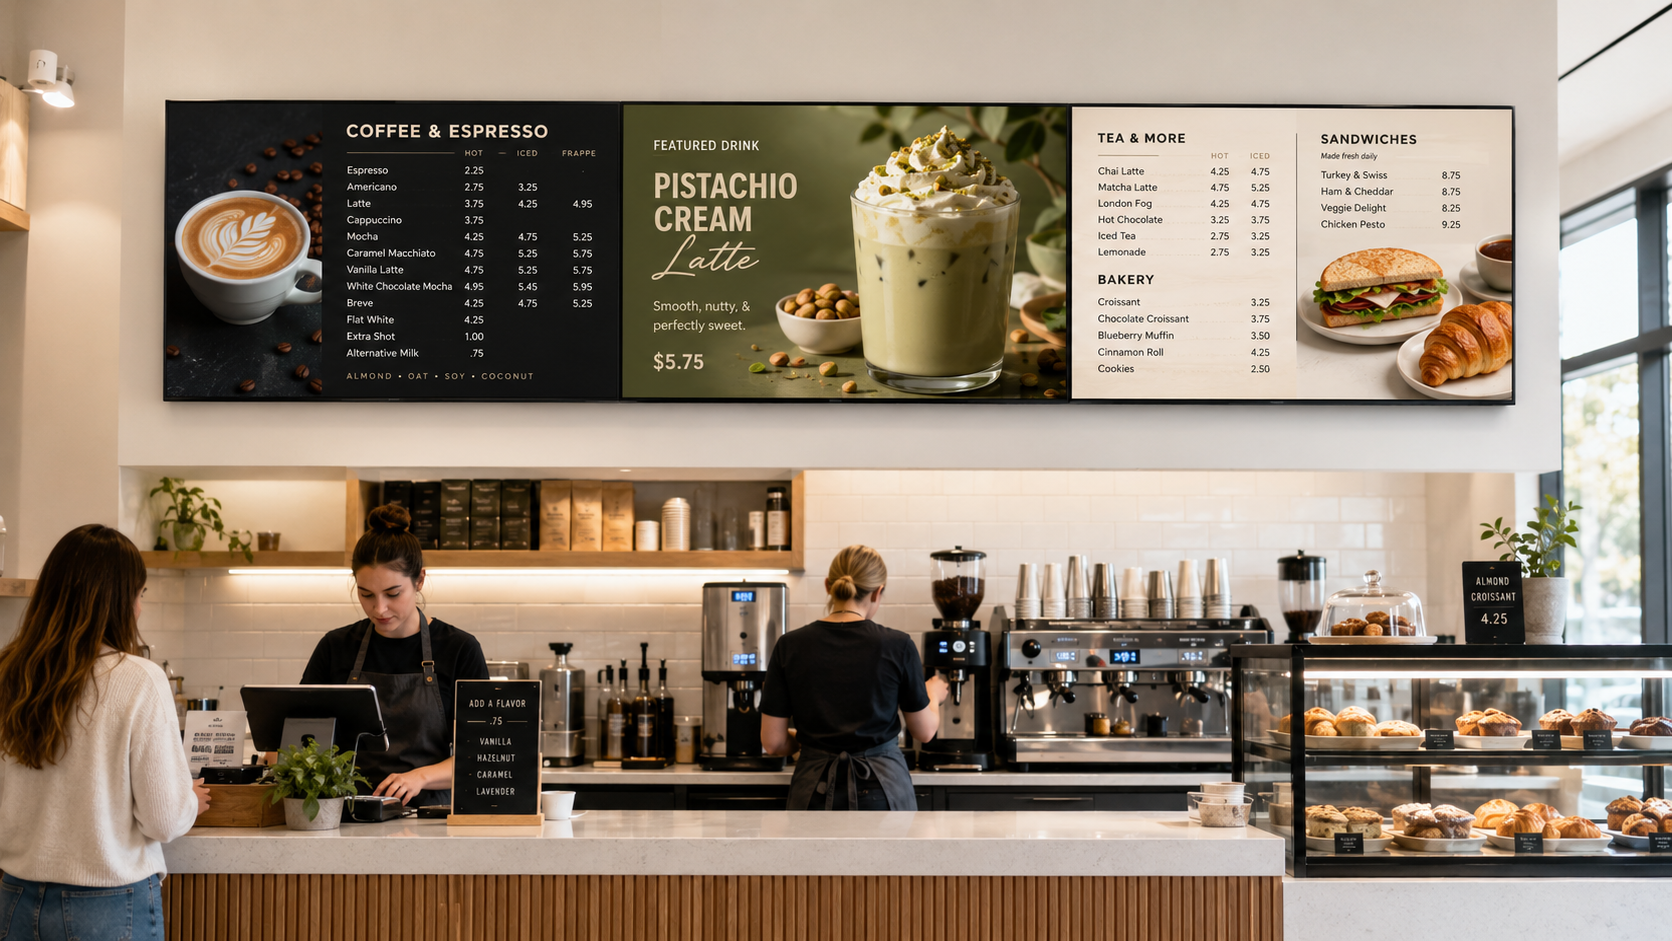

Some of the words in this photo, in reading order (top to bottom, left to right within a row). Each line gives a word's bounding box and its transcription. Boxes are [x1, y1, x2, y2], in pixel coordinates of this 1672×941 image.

[346, 123, 421, 138] COFFEE
[428, 124, 442, 139] &
[449, 124, 549, 139] ESPRESSO
[1097, 132, 1125, 144] TEA
[1129, 132, 1139, 144] &
[1144, 132, 1186, 144] MORE
[1320, 133, 1417, 145] SANDWICHES
[653, 139, 717, 151] FEATURED
[721, 139, 760, 151] DRINK
[464, 149, 484, 157] HOT
[516, 149, 538, 157] ICED
[561, 149, 596, 157] FRAPPE
[1210, 152, 1229, 160] HOT
[1249, 152, 1271, 160] ICED
[1320, 152, 1341, 160] Made
[1341, 151, 1360, 160] fresh
[1360, 152, 1379, 162] daily
[347, 165, 389, 176] Espresso
[464, 165, 485, 175] 2.25
[1097, 166, 1119, 176] Chai
[1121, 166, 1145, 176] Latte
[1210, 167, 1230, 176] 4.25
[1250, 167, 1270, 176] 4.75
[1320, 170, 1352, 182] Turkey
[1353, 170, 1361, 180] &
[1362, 170, 1388, 180] Swiss
[1441, 170, 1461, 180] 8.75
[346, 181, 398, 192] Americano
[464, 182, 484, 192] 2.75
[518, 182, 538, 192] 3.25
[654, 172, 798, 200] PISTACHIO
[1098, 182, 1132, 192] Matcha
[1134, 183, 1158, 192] Latte
[1210, 183, 1230, 193] 4.75
[1251, 183, 1270, 193] 5.25
[1320, 186, 1343, 196] Ham
[1344, 186, 1352, 196] &
[1353, 186, 1394, 196] Cheddar
[1441, 187, 1461, 197] 8.75
[346, 199, 372, 208] Latte
[464, 199, 484, 209] 3.75
[517, 199, 538, 209] 4.25
[572, 199, 593, 209] 4.95
[1097, 198, 1133, 208] London
[1134, 198, 1153, 210] Fog
[1210, 199, 1230, 208] 4.25
[1250, 199, 1270, 209] 4.75
[1320, 203, 1353, 215] Veggie
[1354, 203, 1387, 215] Delight
[1441, 203, 1461, 213] 8.25
[346, 215, 403, 227] Cappuccino
[464, 215, 484, 225] 3.75
[654, 205, 752, 232] CREAM
[1097, 215, 1115, 224] Hot
[1116, 215, 1164, 224] Chocolate
[1210, 215, 1230, 225] 3.25
[1251, 215, 1270, 225] 3.75
[1320, 219, 1358, 229] Chicken
[1359, 219, 1386, 229] Pesto
[1441, 220, 1461, 229] 9.25
[346, 231, 379, 241] Mocha
[464, 232, 484, 242] 4.25
[517, 232, 538, 242] 4.75
[572, 232, 593, 242] 5.25
[1097, 231, 1118, 241] Iced
[1119, 231, 1136, 241] Tea
[1210, 231, 1230, 241] 2.75
[1251, 231, 1270, 241] 3.25
[346, 248, 386, 258] Caramel
[388, 248, 436, 258] Macchiato
[464, 248, 485, 258] 4.75
[518, 248, 538, 259] 5.25
[572, 248, 593, 259] 5.75
[651, 233, 760, 281] Latte
[1097, 247, 1147, 257] Lemonade
[1210, 247, 1230, 257] 2.75
[1250, 247, 1271, 257] 3.25
[346, 264, 378, 275] Vanilla
[379, 265, 404, 275] Latte
[464, 265, 484, 275] 4.75
[518, 265, 538, 275] 5.25
[572, 265, 593, 275] 5.75
[1097, 274, 1155, 285] BAKERY
[346, 281, 374, 291] White
[375, 281, 421, 291] Chocolate
[422, 281, 453, 291] Mocha
[464, 282, 485, 291] 4.95
[518, 282, 538, 292] 5.45
[572, 282, 593, 292] 5.95
[346, 298, 374, 308] Breve
[464, 298, 485, 308] 4.25
[517, 298, 538, 308] 4.75
[572, 298, 593, 308] 5.25
[653, 300, 702, 314] Smooth,
[705, 301, 738, 315] nutty,
[741, 300, 751, 312] &
[1097, 297, 1141, 307] Croissant
[1250, 297, 1271, 307] 3.25
[346, 314, 364, 324] Flat
[366, 314, 395, 325] White
[463, 315, 484, 325] 4.25
[1097, 313, 1145, 324] Chocolate
[1146, 314, 1190, 324] Croissant
[1251, 314, 1271, 324] 3.75
[653, 318, 706, 334] perfectly
[708, 320, 746, 331] sweet.
[346, 331, 372, 341] Extra
[373, 331, 396, 341] Shot
[465, 331, 485, 342] 1.00
[1097, 330, 1143, 342] Blueberry
[1144, 330, 1175, 340] Muffin
[1250, 330, 1271, 341] 3.50
[346, 348, 398, 358] Alternative
[399, 348, 419, 358] Milk
[470, 348, 484, 358] .75
[1097, 347, 1145, 357] Cinnamon
[1146, 347, 1164, 357] Roll
[1250, 347, 1271, 357] 4.25
[653, 351, 704, 372] $5.75
[1097, 363, 1135, 373] Cookies
[1250, 364, 1271, 374] 2.50
[346, 372, 392, 380] ALMOND
[407, 372, 429, 380] OAT
[444, 372, 465, 380] SOY
[480, 372, 534, 380] COCONUT
[1475, 576, 1510, 586] ALMOND
[1470, 591, 1516, 602] CROISSANT
[1480, 612, 1508, 625] 4.25
[468, 699, 485, 708] ADD
[487, 699, 494, 708] A
[496, 698, 526, 708] FLAVOR
[489, 716, 503, 726] .75
[479, 737, 512, 746] VANILLA
[476, 753, 516, 763] HAZELNUT
[476, 770, 513, 779] CARAMEL
[476, 787, 516, 796] LAVENDER
